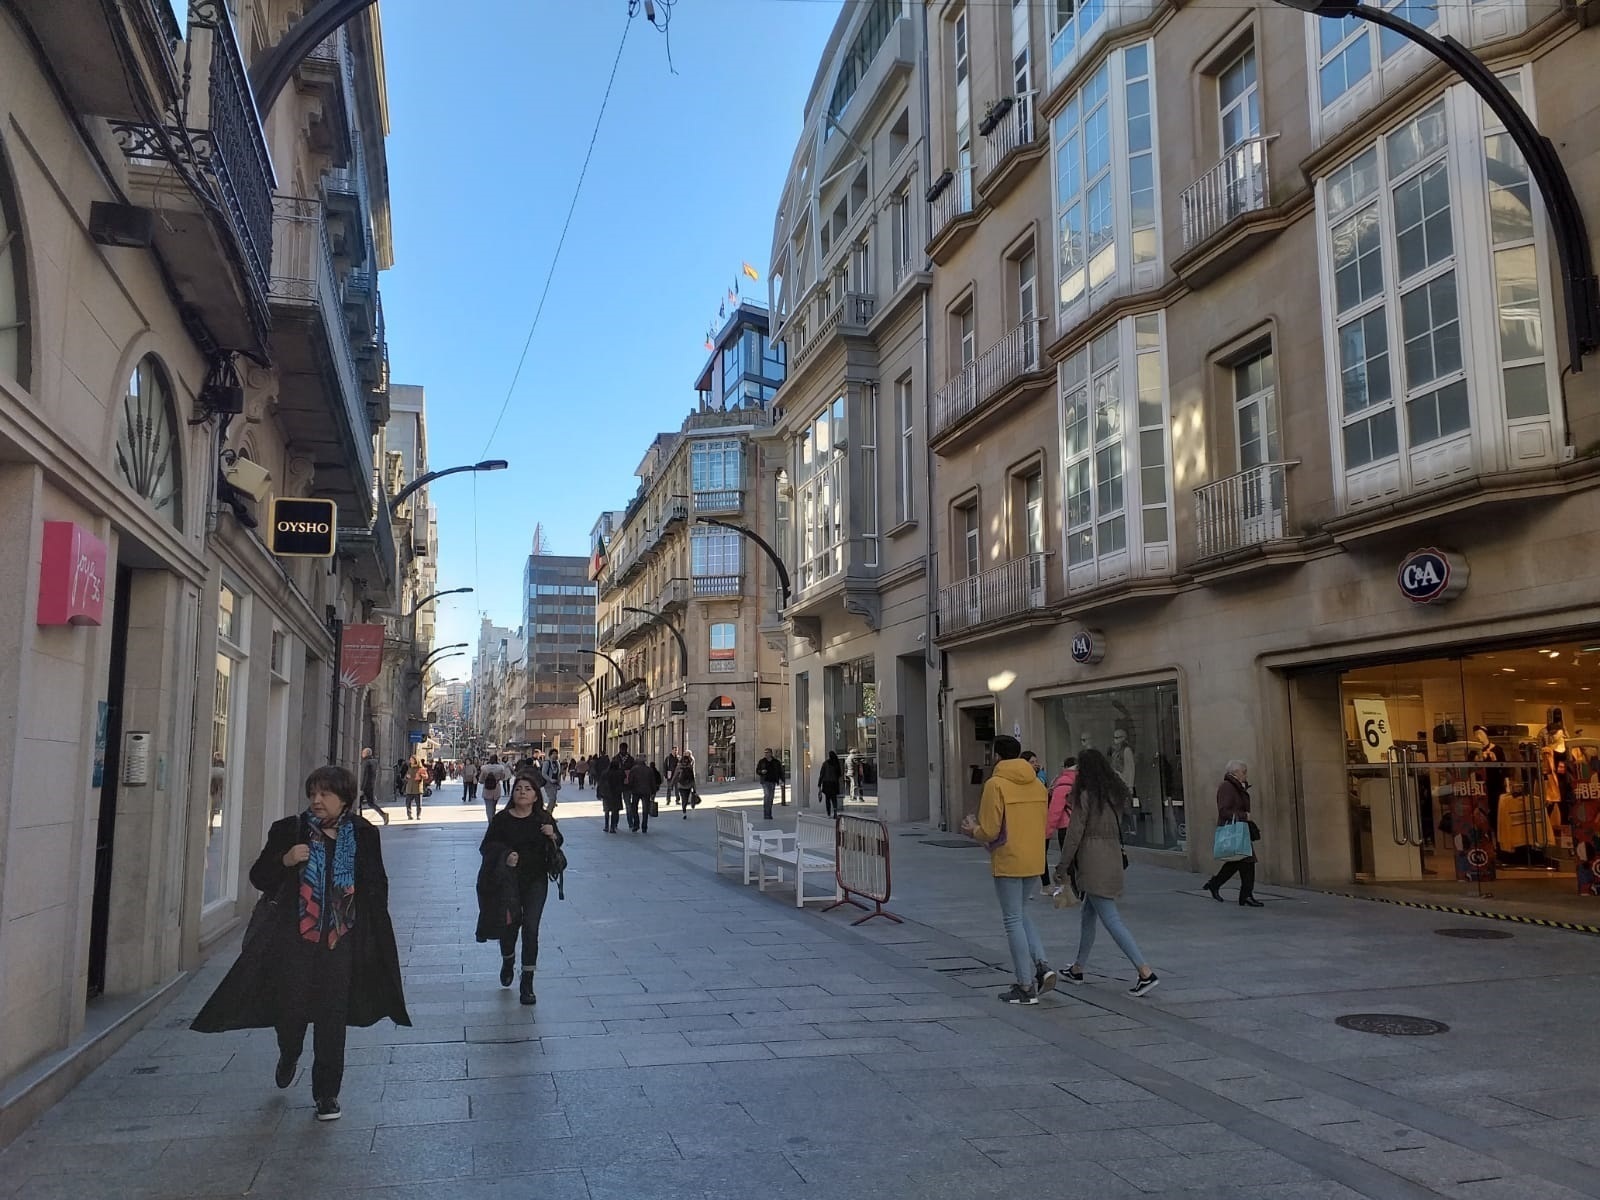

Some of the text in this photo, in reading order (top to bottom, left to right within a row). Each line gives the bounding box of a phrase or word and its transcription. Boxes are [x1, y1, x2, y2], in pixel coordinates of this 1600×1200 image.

[277, 521, 329, 534] OYSHO
[1403, 560, 1441, 589] C&A
[1364, 719, 1387, 747] 6€
